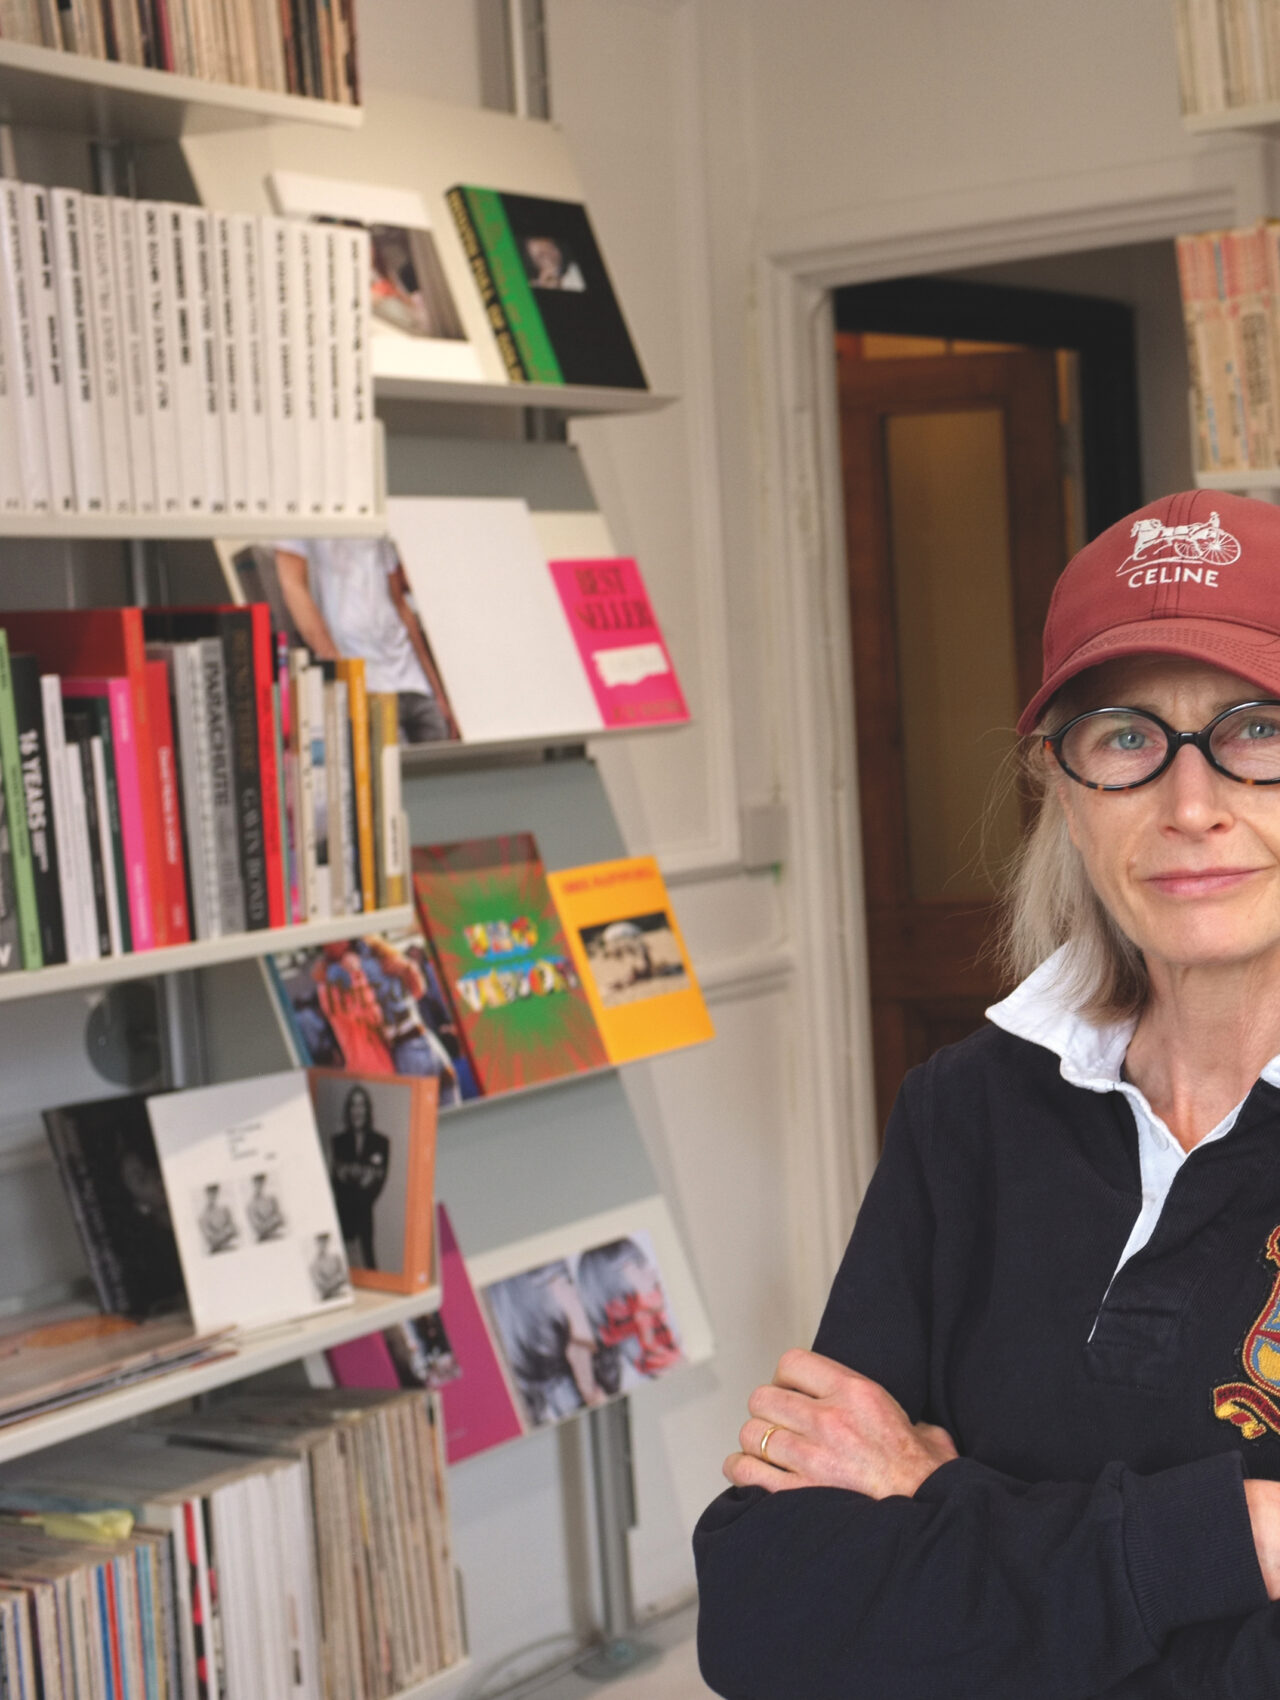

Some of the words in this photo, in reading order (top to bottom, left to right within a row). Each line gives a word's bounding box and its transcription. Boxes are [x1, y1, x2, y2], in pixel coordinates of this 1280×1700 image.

[1128, 566, 1219, 588] CELINE
[20, 729, 39, 755] 16
[205, 662, 229, 808] PARACHUTE
[22, 757, 46, 832] YEARS
